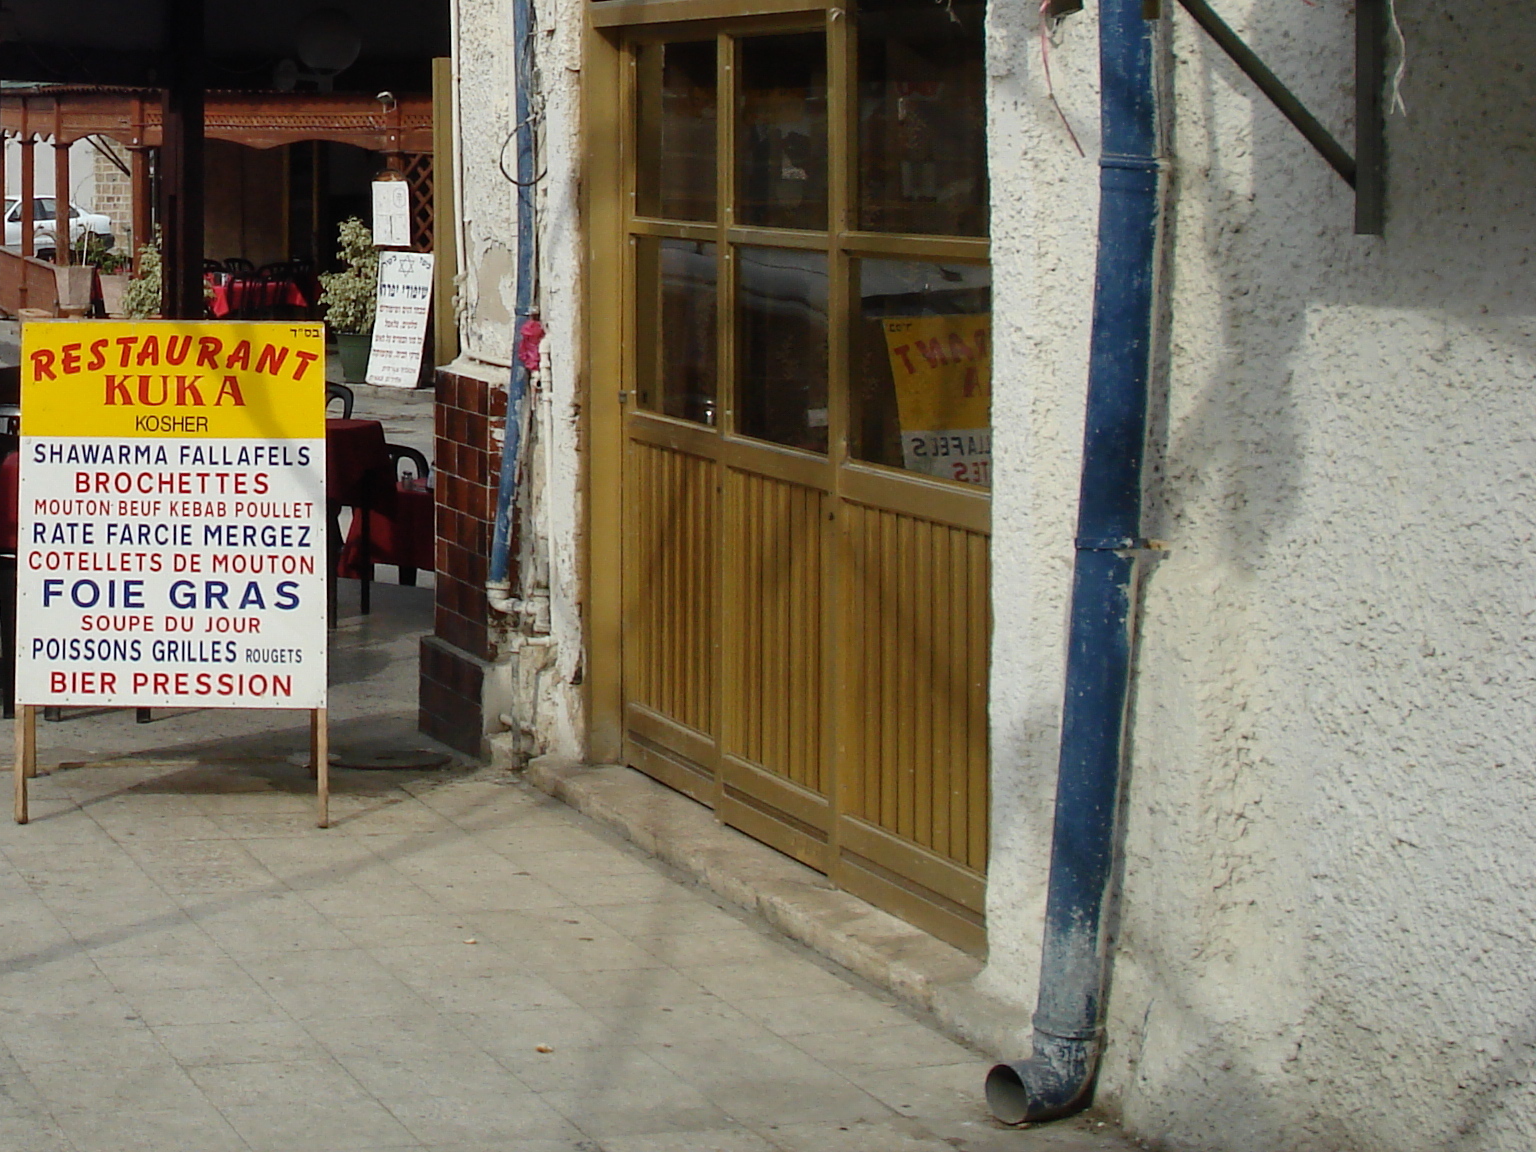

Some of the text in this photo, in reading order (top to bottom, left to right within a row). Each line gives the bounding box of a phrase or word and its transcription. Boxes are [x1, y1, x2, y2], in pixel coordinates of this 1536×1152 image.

[30, 335, 319, 382] RESTAURANT
[104, 374, 246, 406] KUKA
[135, 415, 208, 432] KOSHER
[33, 443, 310, 466] SHAWARMA FALLAFELS
[75, 471, 269, 494] BROCHETTES
[35, 499, 314, 518] MOUTON BEUF KEBAB POULLET
[33, 522, 311, 547] RATE FARCIE MERGEZ
[28, 550, 314, 574] COTELLETS DE MOUTON
[43, 578, 300, 609] FOIE GRAS
[81, 615, 261, 633] SOUPE DU JOUR
[32, 638, 302, 663] POISSONS GRILLES ROUGETS
[50, 671, 292, 697] BIER PRESSION
